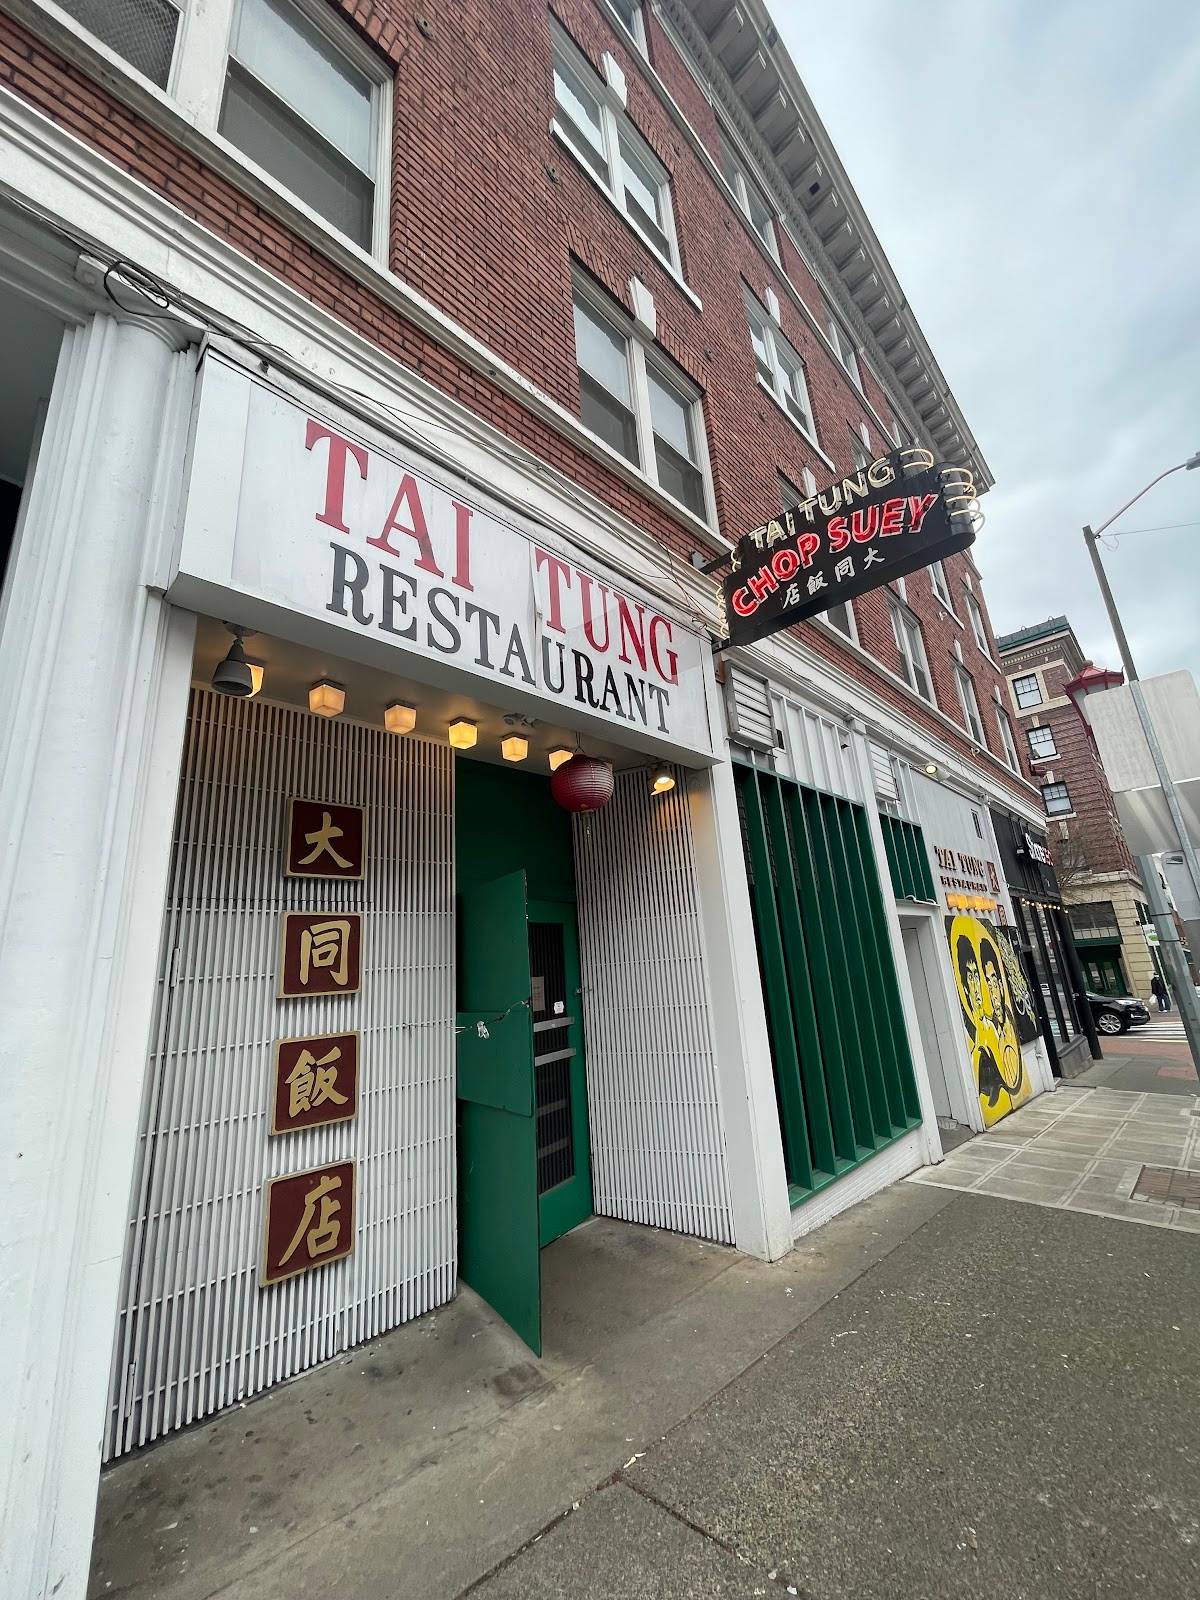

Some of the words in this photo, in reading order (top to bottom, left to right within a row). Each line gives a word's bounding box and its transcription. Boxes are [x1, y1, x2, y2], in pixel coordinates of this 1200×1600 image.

[305, 418, 475, 592] TAI
[535, 546, 680, 686] TUNG
[731, 532, 821, 618] CHOP
[826, 492, 939, 554] SUEY
[748, 512, 797, 552] TAI
[798, 457, 896, 524] TUNG
[325, 541, 670, 735] RESTAURANT
[933, 845, 956, 871] TAI
[957, 852, 985, 878] TUNG
